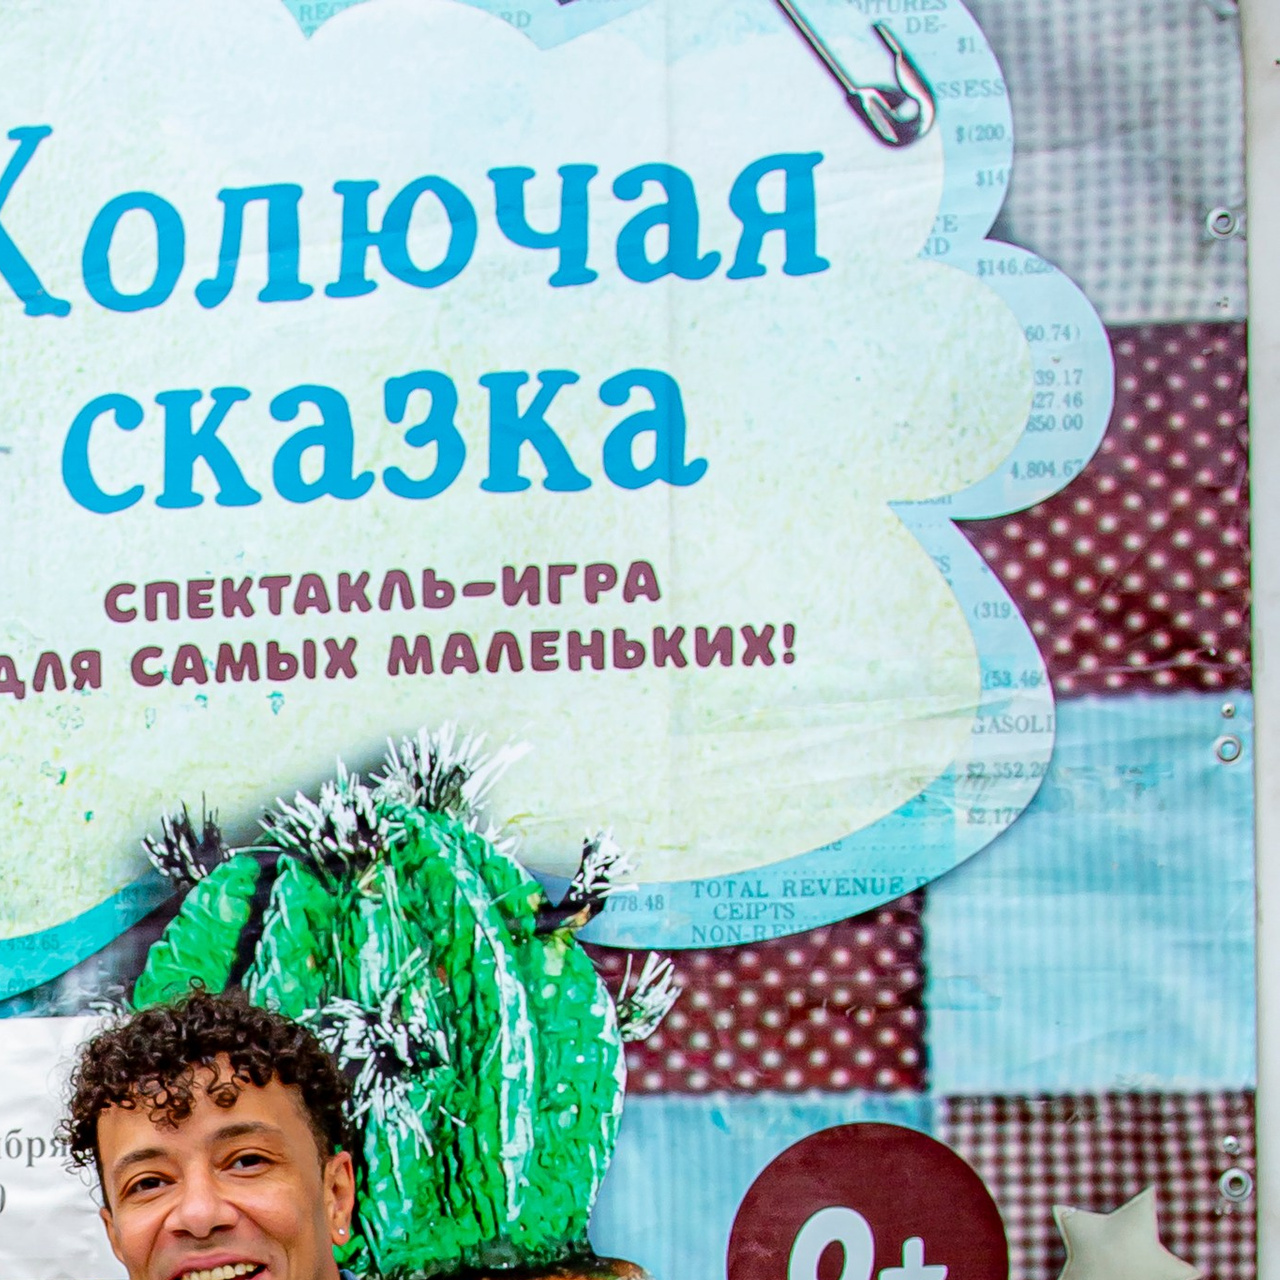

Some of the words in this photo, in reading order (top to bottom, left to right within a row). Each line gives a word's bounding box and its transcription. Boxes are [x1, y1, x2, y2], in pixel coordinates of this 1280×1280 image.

[61, 368, 708, 514] сказка
[103, 560, 662, 624] СПЕКТАКЛЬ-ИГРА
[129, 636, 359, 687] САМЫХ
[386, 623, 797, 679] МАЛЕНЬКИХ!
[691, 879, 769, 899] TOTAL
[782, 876, 904, 898] REVENUE
[713, 902, 795, 921] CEIPTS
